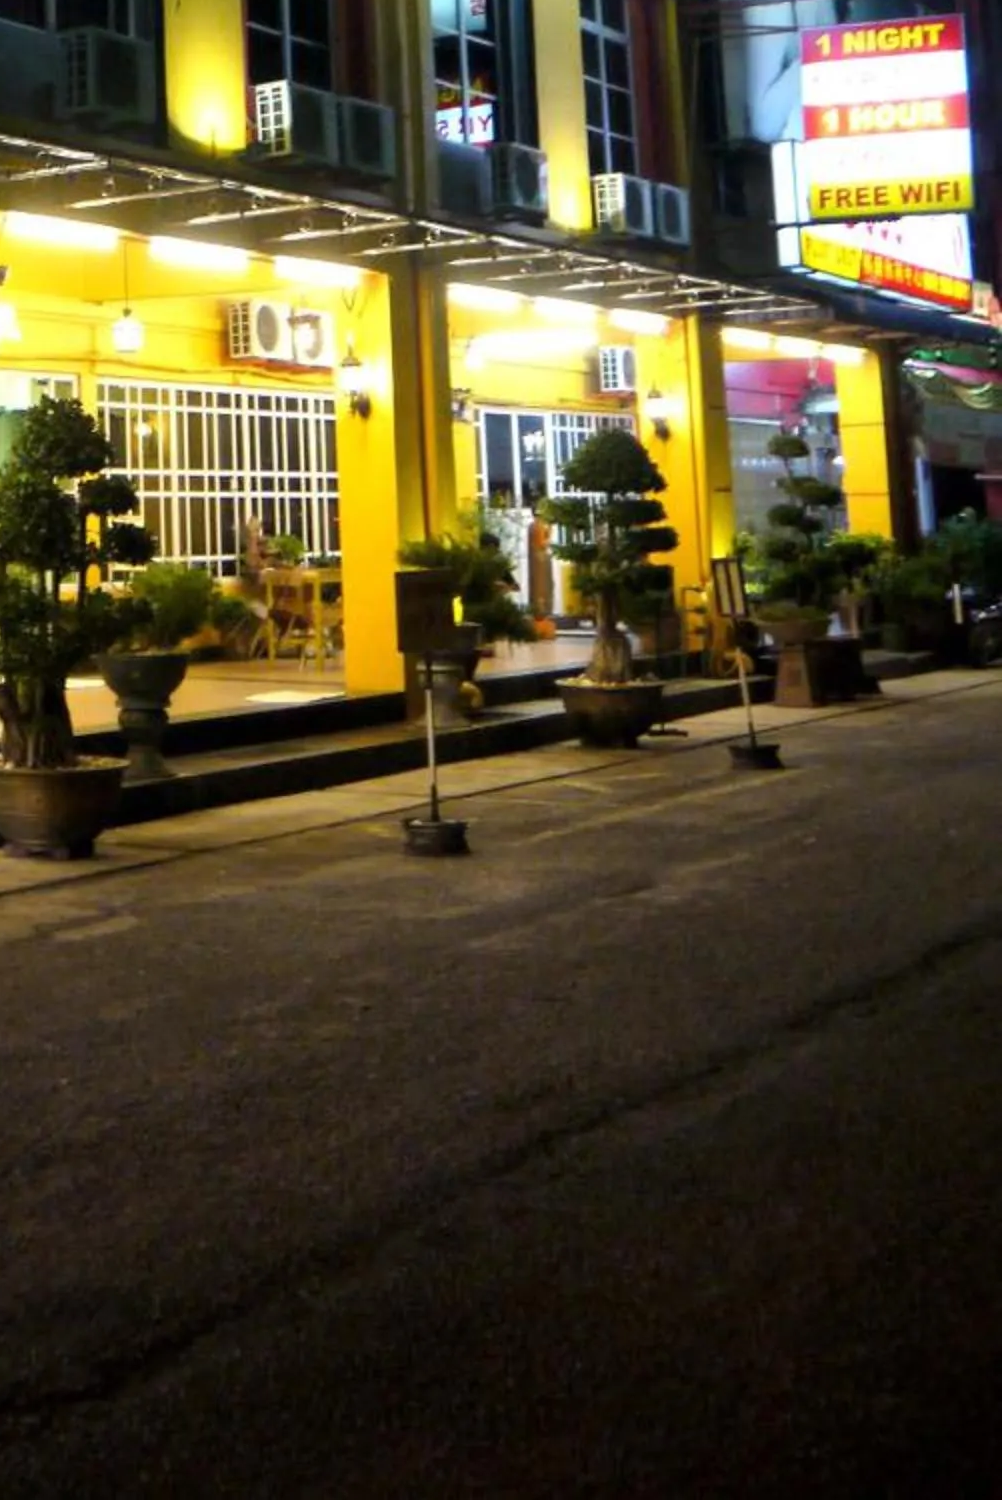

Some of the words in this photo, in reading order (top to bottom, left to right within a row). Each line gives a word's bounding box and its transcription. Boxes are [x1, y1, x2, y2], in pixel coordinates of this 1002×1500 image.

[815, 33, 832, 56] 1
[843, 23, 945, 54] NIGHT
[823, 107, 839, 133] 1
[849, 101, 945, 132] HOUR
[818, 185, 889, 210] FREE
[900, 180, 961, 205] WIFI
